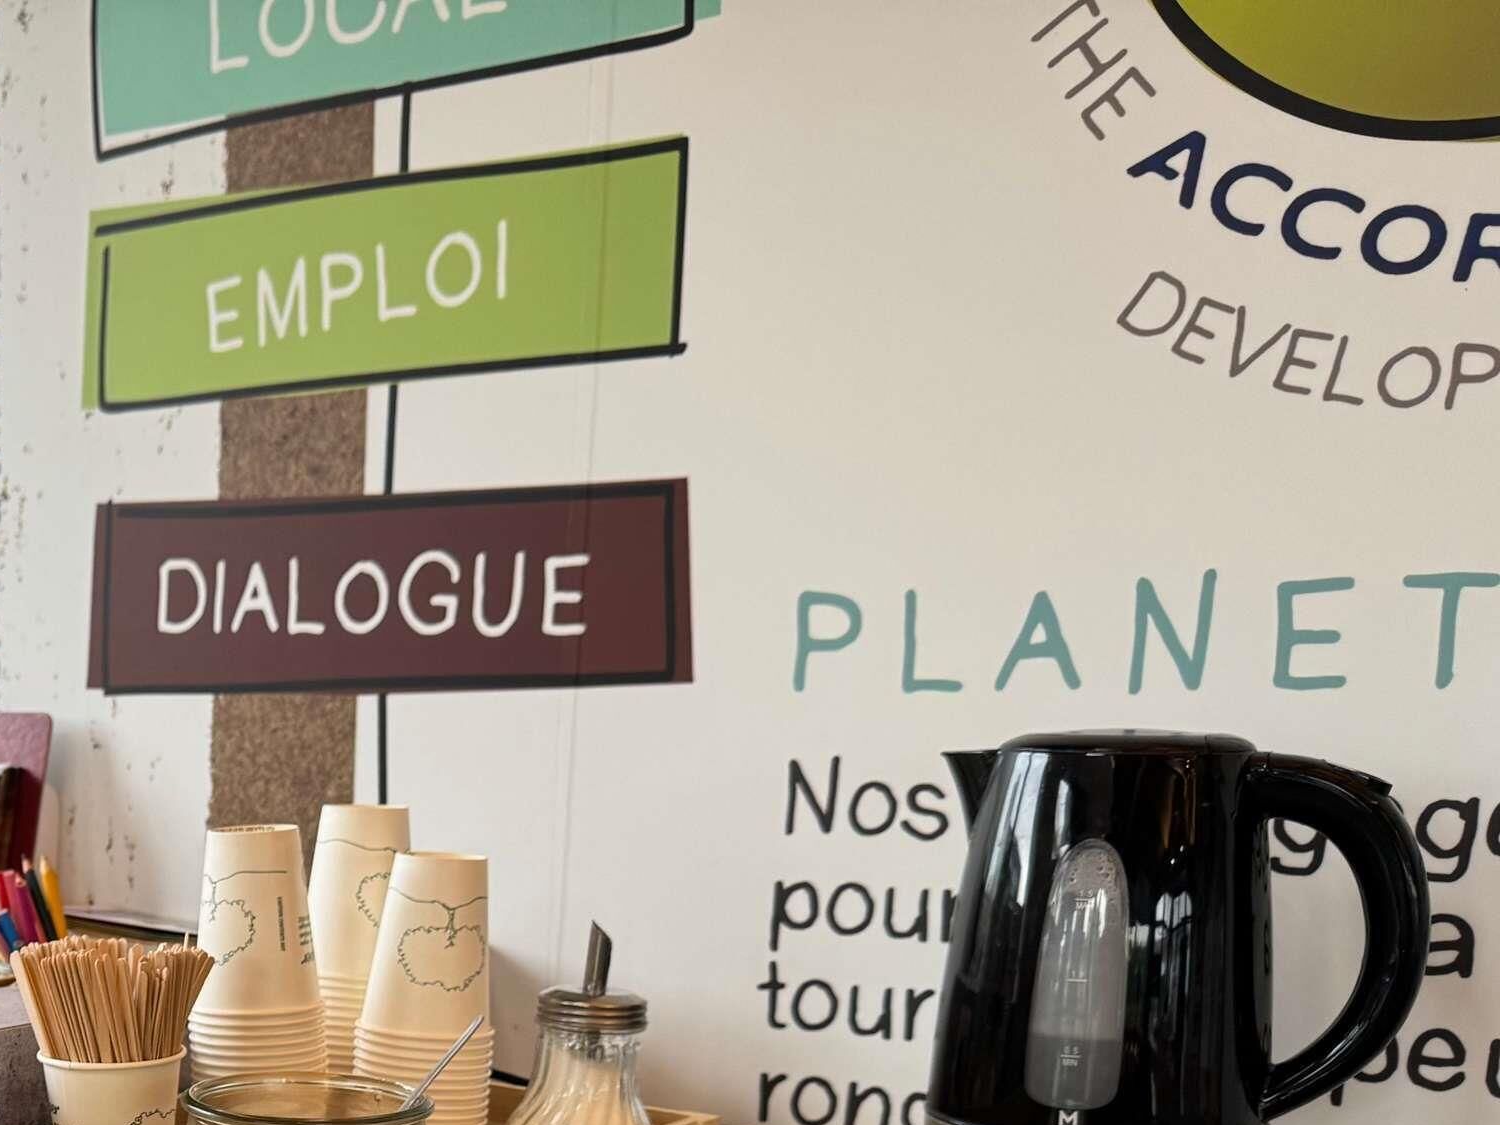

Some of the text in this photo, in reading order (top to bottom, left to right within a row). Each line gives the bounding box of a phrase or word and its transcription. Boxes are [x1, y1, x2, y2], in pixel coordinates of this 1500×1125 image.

[208, 0, 508, 74] LOC
[1030, 0, 1157, 142] THE
[205, 218, 509, 354] EMPLOI
[1116, 271, 1500, 411] DEVELOP
[156, 549, 591, 638] DIALOGUE
[792, 568, 1500, 695] PLANET
[785, 756, 949, 840] Nos
[757, 960, 935, 1042] tour
